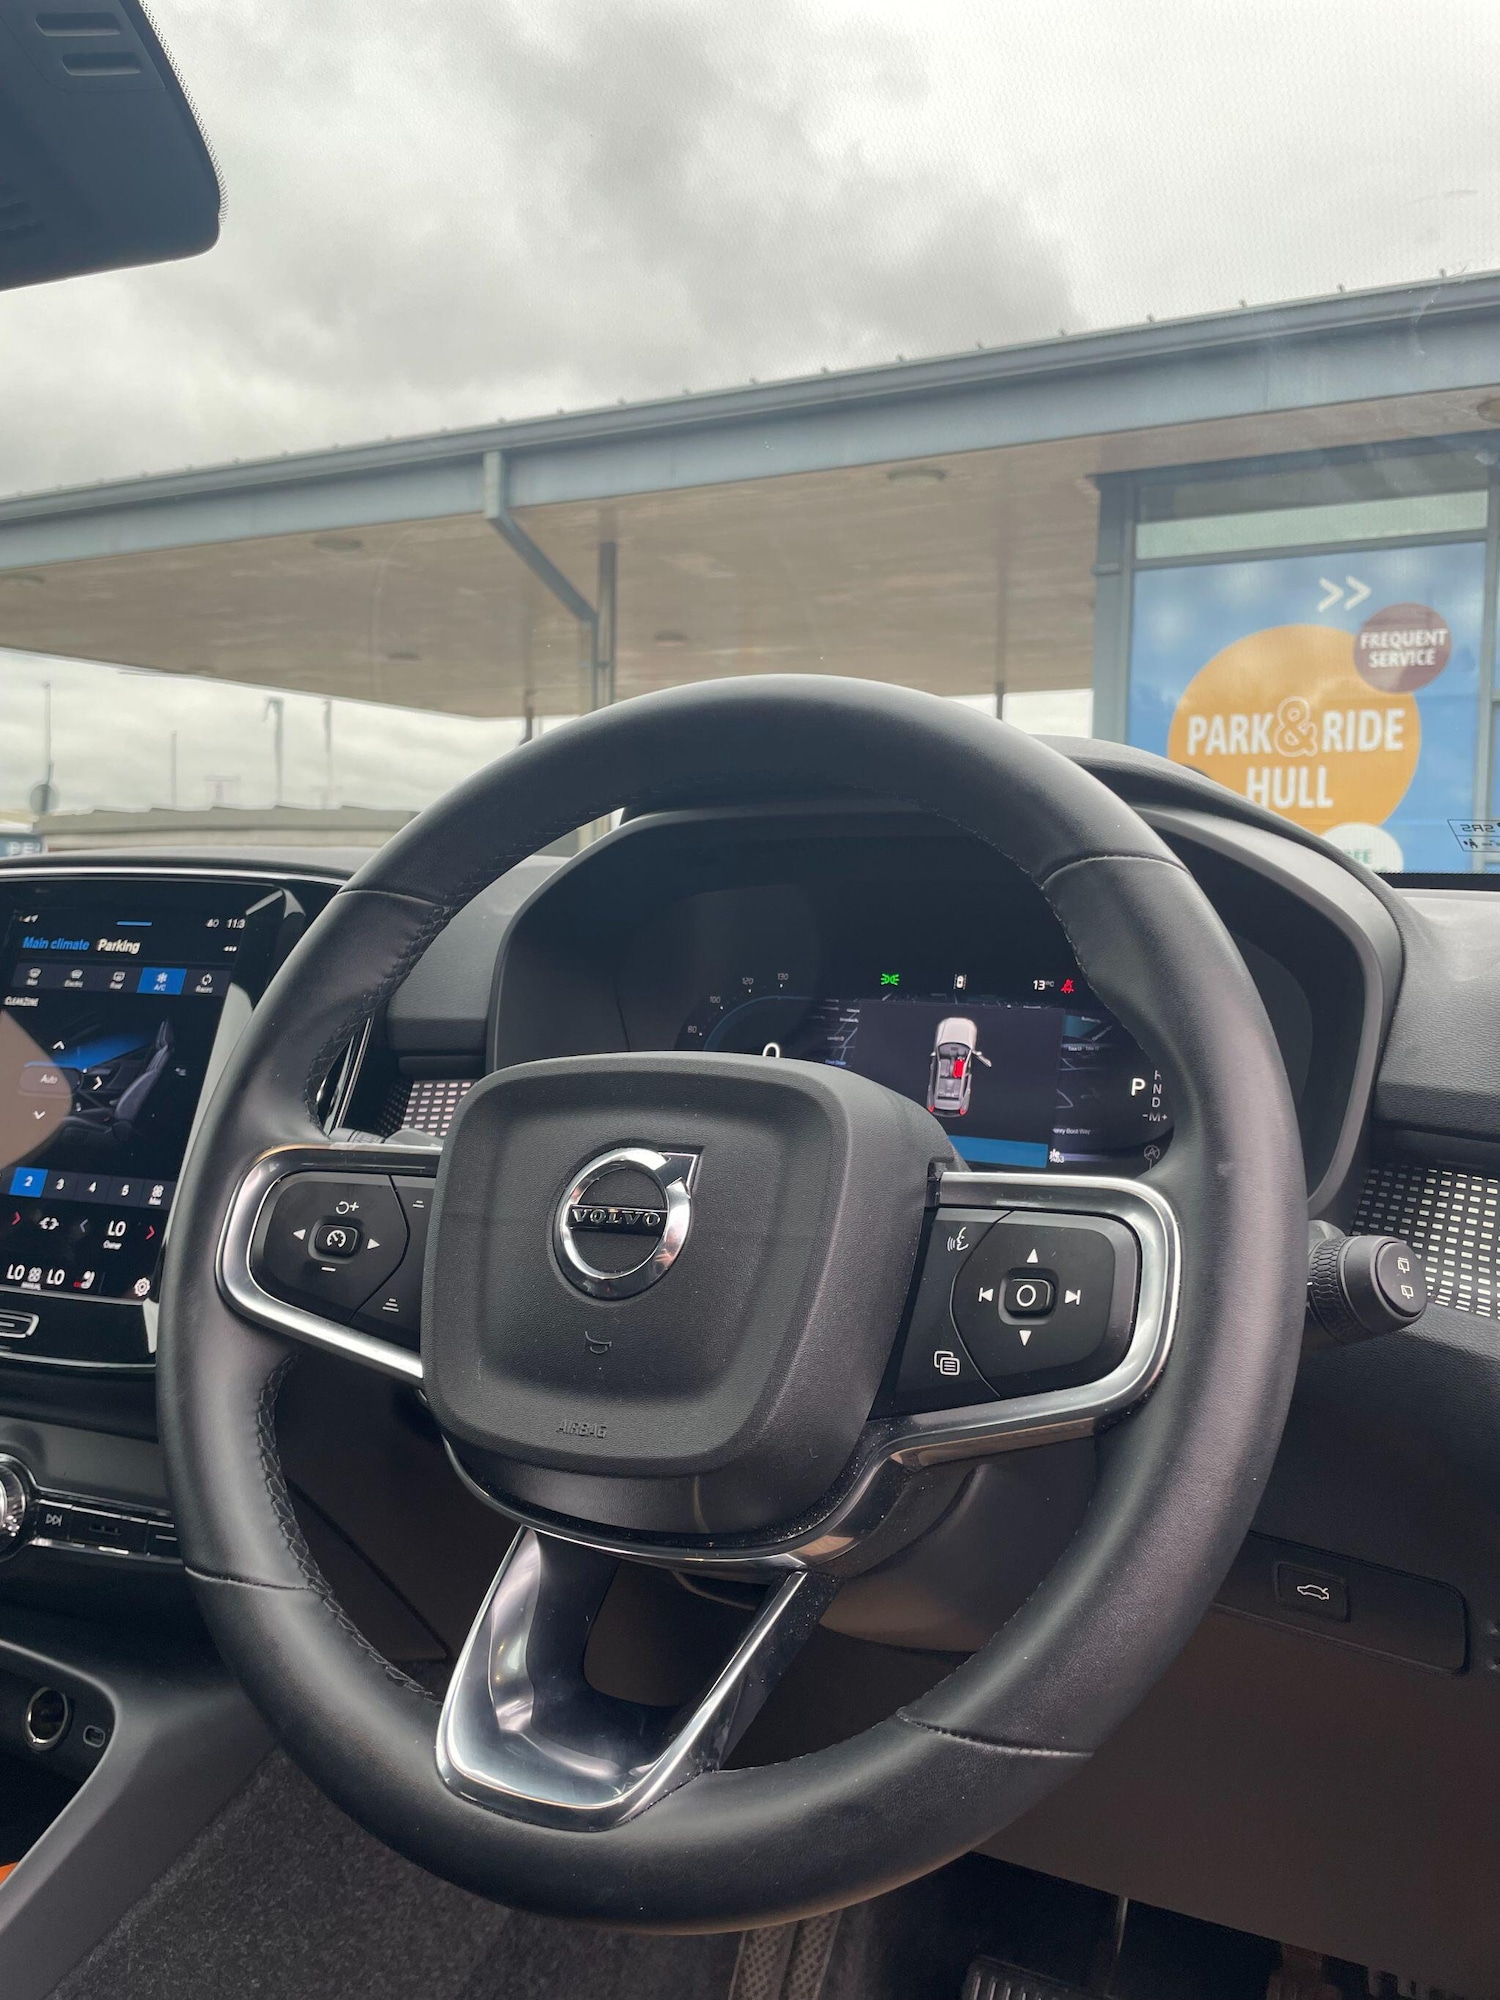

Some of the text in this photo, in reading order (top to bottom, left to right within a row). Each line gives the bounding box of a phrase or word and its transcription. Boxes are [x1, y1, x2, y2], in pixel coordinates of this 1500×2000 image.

[1360, 628, 1449, 651] FREQUENT
[1368, 648, 1436, 668] SERVICE
[1187, 712, 1274, 756] PARK
[1321, 707, 1406, 753] RIDE
[1246, 765, 1334, 809] HULL
[22, 936, 140, 955] Main climate Parking
[742, 977, 754, 985] 120
[777, 973, 789, 981] 130
[709, 996, 721, 1004] 100
[687, 1025, 698, 1034] 80
[1131, 1077, 1146, 1096] P
[1152, 1083, 1162, 1095] N
[1151, 1096, 1161, 1108] D
[24, 1175, 34, 1187] 2
[55, 1177, 65, 1190] 3
[88, 1181, 97, 1193] 4
[121, 1184, 130, 1196] 5
[572, 1207, 661, 1226] VOLVO
[107, 1219, 127, 1237] LO
[6, 1263, 26, 1280] LO
[46, 1268, 66, 1285] LO
[556, 1420, 607, 1438] AIRBAG
